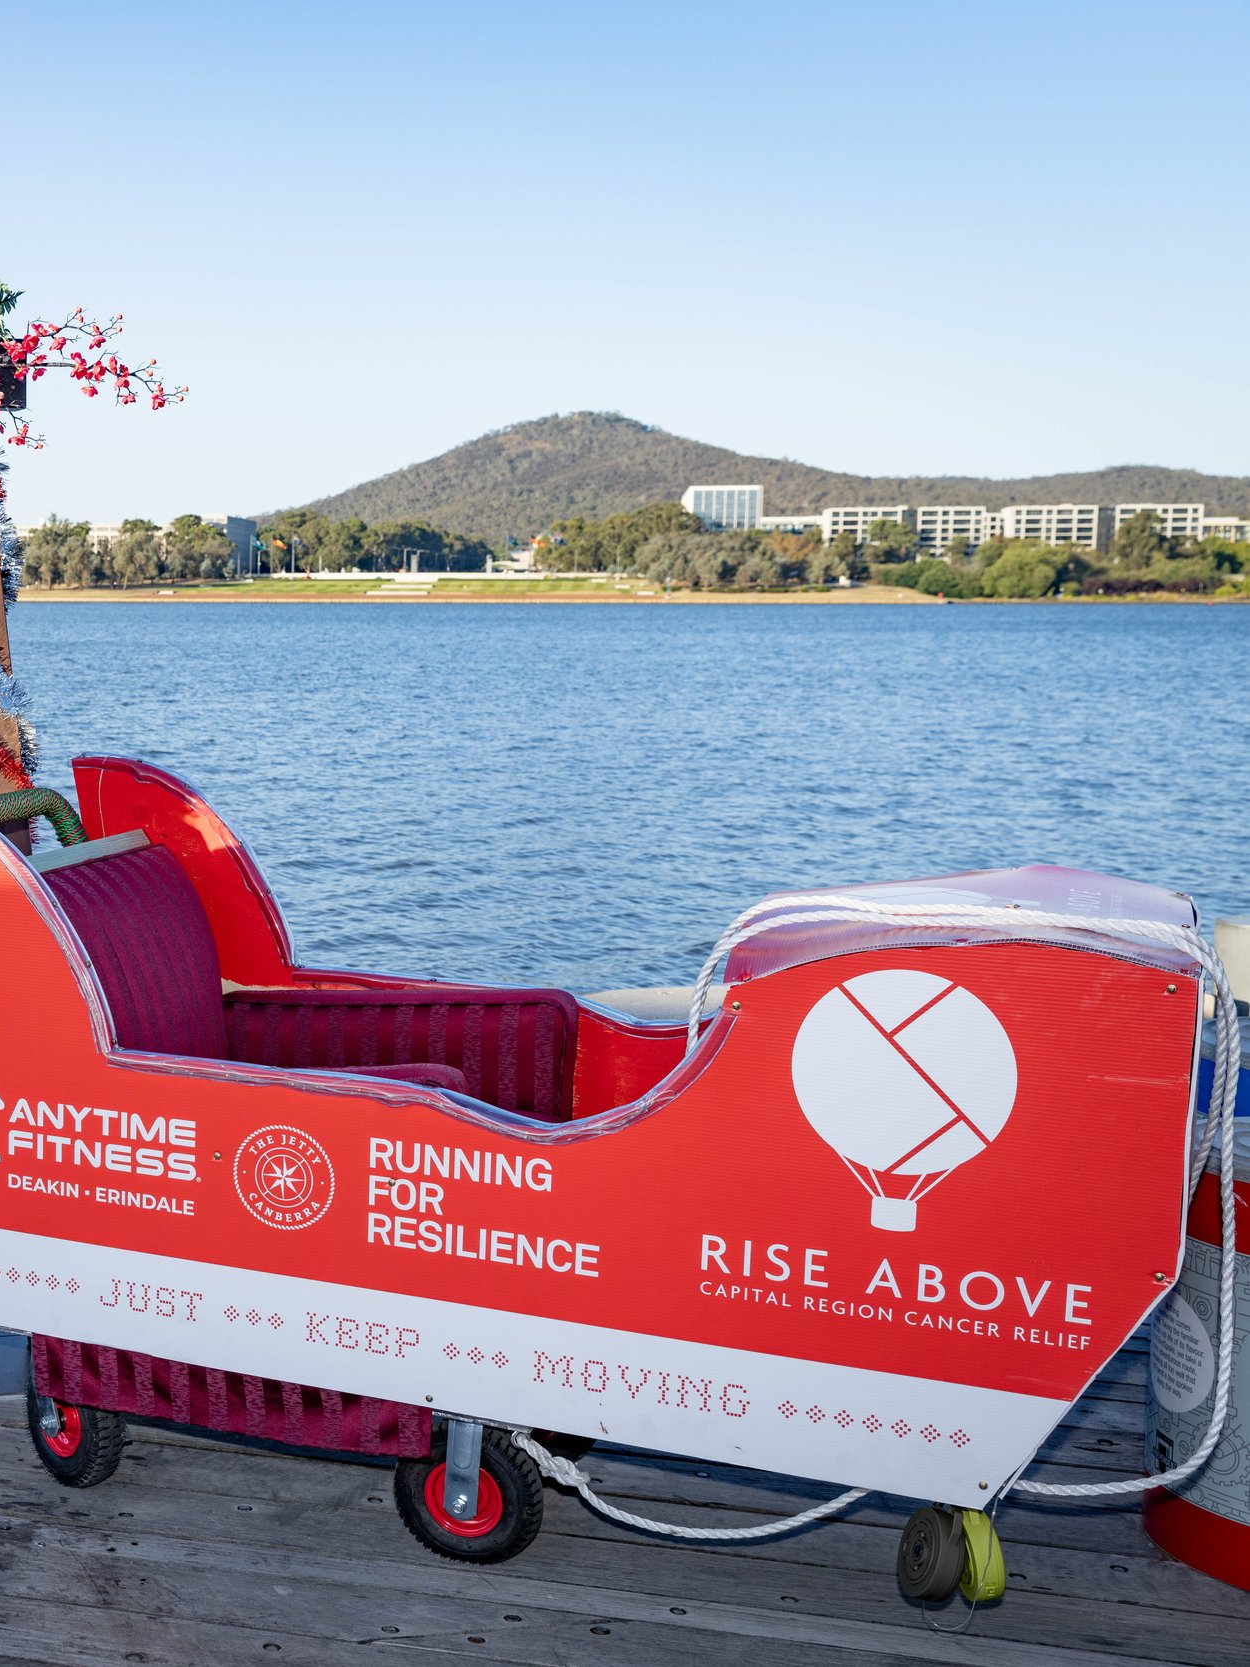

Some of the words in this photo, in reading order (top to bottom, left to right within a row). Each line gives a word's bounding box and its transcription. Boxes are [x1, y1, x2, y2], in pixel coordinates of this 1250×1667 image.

[9, 1098, 196, 1147] ANYTIME
[8, 1130, 196, 1181] FITNESS
[249, 1135, 274, 1155] THE
[281, 1134, 321, 1164] JETTY
[369, 1137, 552, 1192] RUNNING
[8, 1173, 79, 1198] DEAKIN
[95, 1187, 195, 1216] ERINDALE
[249, 1193, 320, 1222] CANBERRA
[368, 1175, 444, 1216] FOR
[367, 1212, 600, 1278] RESILIENCE
[701, 1234, 828, 1288] RISE
[865, 1258, 1092, 1325] ABOVE
[700, 1282, 792, 1307] CAPITAL
[803, 1296, 893, 1322] REGION
[904, 1311, 1000, 1338] CANCER
[1014, 1326, 1091, 1350] RELIEF
[100, 1278, 202, 1322] JUST
[306, 1311, 420, 1358] KEEP
[534, 1350, 750, 1417] MOVING
